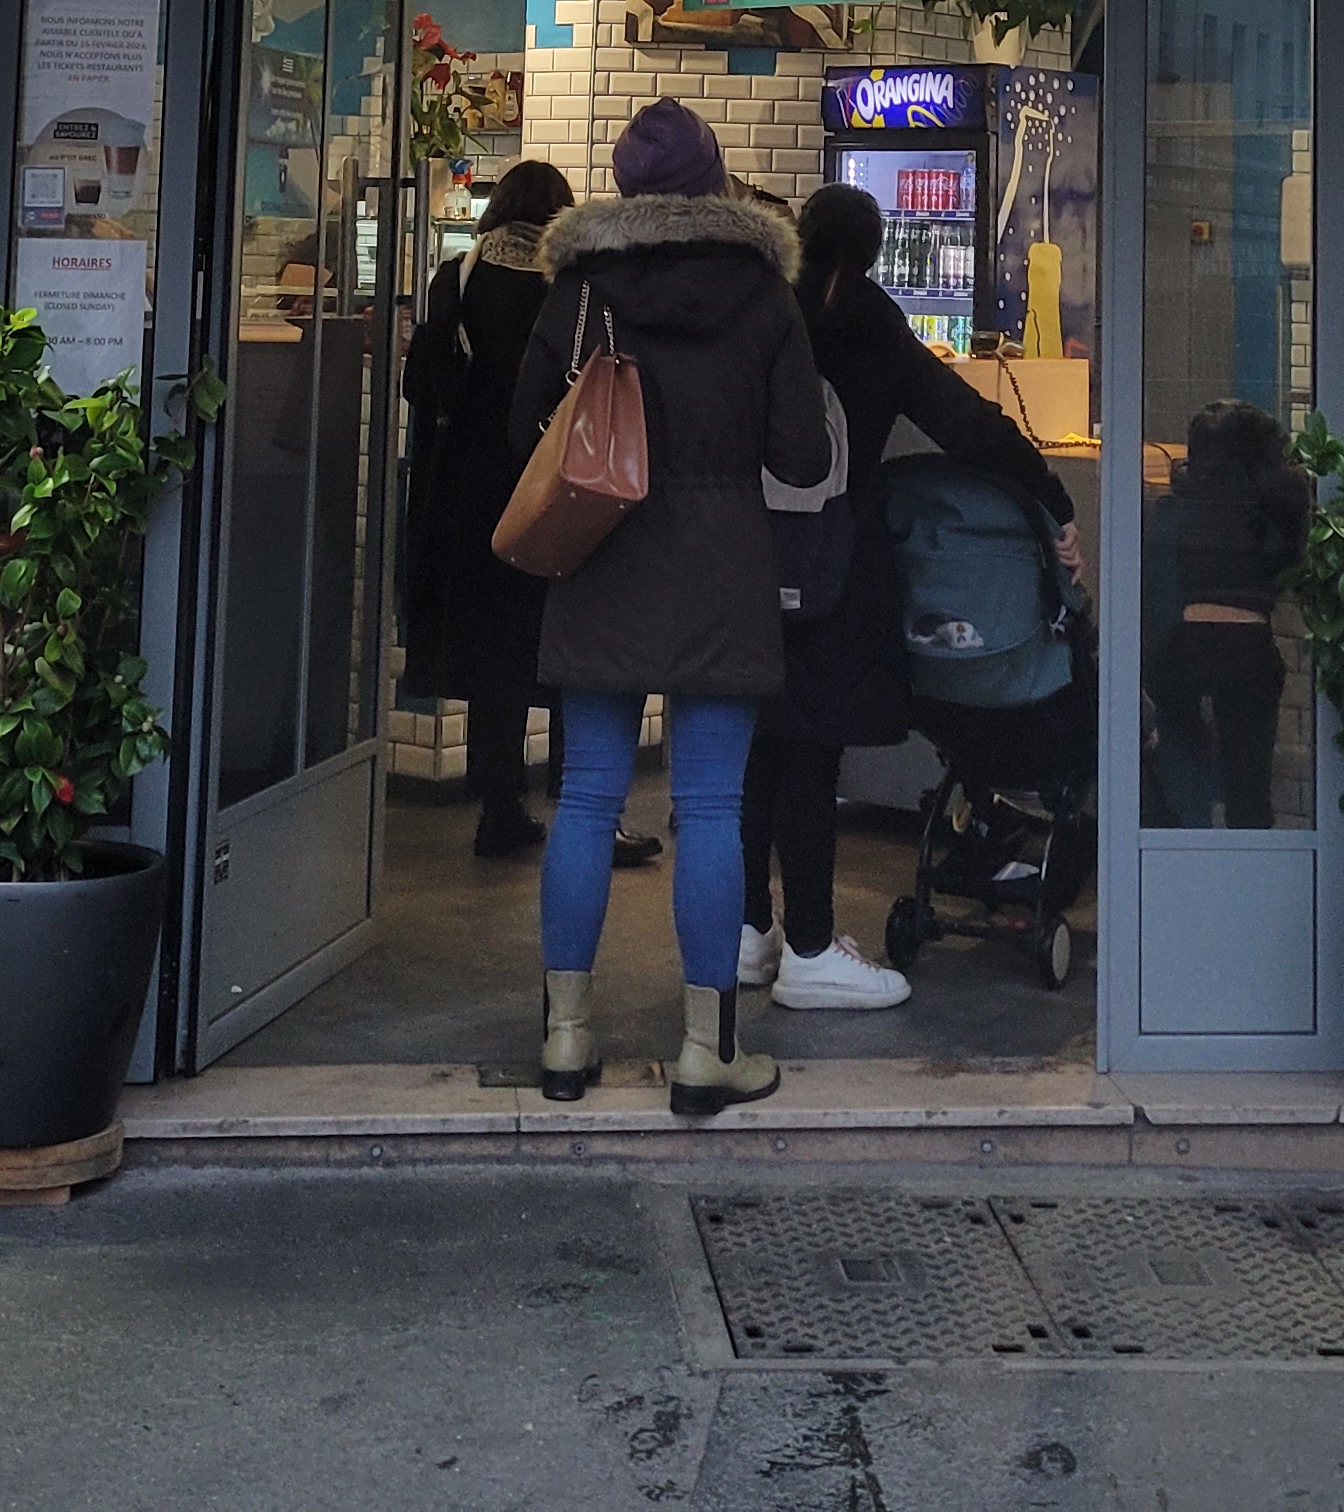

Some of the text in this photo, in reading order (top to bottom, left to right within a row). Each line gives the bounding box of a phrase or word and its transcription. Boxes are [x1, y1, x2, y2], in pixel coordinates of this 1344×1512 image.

[857, 72, 953, 120] ORANGINA
[52, 257, 112, 268] HORAIRES
[35, 291, 80, 299] FERMETURE
